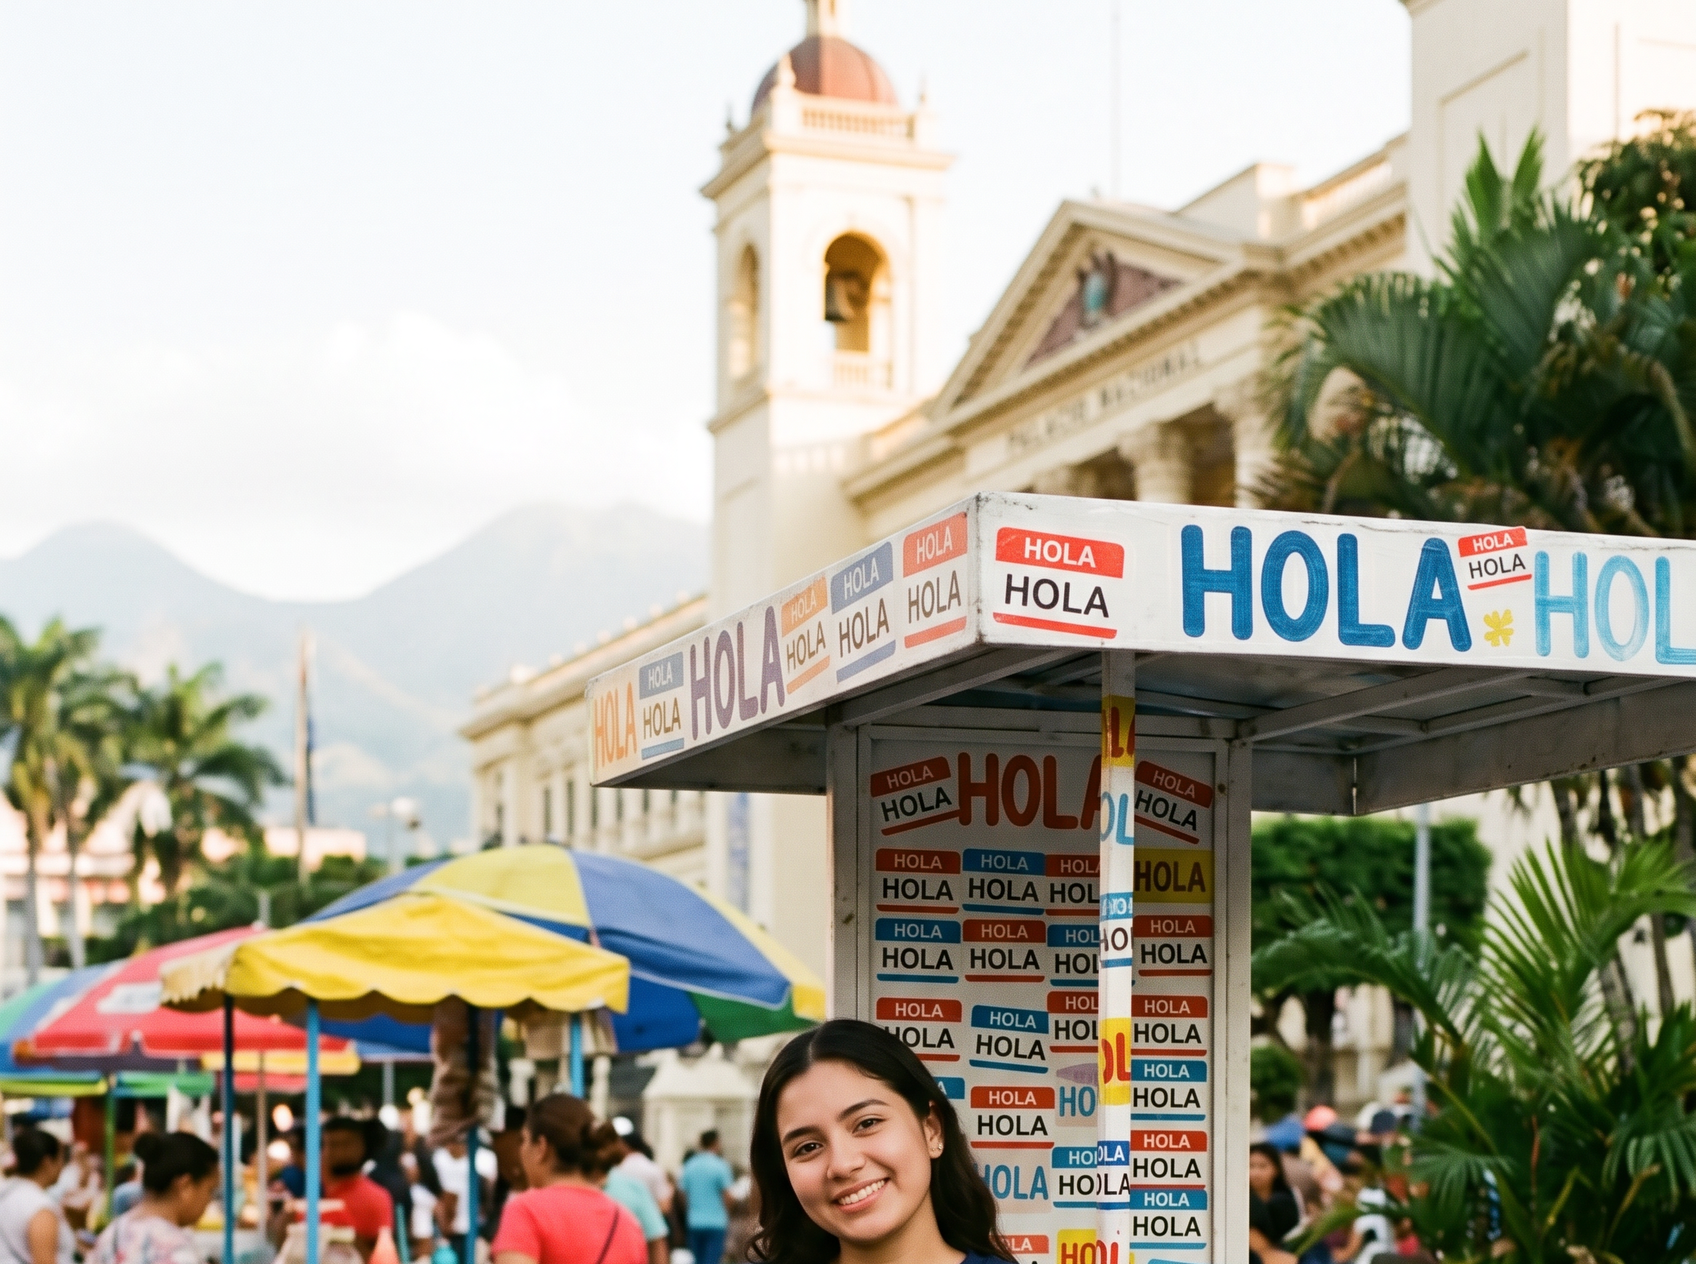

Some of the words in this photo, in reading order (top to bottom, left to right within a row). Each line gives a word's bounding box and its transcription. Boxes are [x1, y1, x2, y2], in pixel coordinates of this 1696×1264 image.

[917, 526, 952, 564] HOLA
[1024, 537, 1096, 568] HOLA
[1473, 533, 1514, 552] HOLA
[1469, 554, 1526, 579] HOLA
[843, 558, 879, 600] HOLA
[1181, 524, 1472, 652] HOLA
[908, 570, 962, 624] HOLA
[1004, 574, 1109, 618] HOLA
[790, 597, 817, 622] HOLA
[1534, 550, 1696, 665] HOL
[838, 598, 890, 658] HOLA
[786, 621, 826, 674] HOLA
[648, 660, 673, 690] HOLA
[689, 606, 785, 741] HOLA
[594, 681, 637, 769] HOLA
[643, 697, 681, 739] HOLA
[887, 766, 934, 789] HOLA
[1152, 770, 1196, 799] HOLA
[881, 787, 952, 822] HOLA
[1134, 789, 1198, 831] HOLA
[894, 854, 942, 869] HOLA
[981, 855, 1028, 871] HOLA
[1134, 861, 1206, 893] HOLA
[883, 878, 954, 901] HOLA
[968, 878, 1039, 902] HOLA
[1050, 883, 1101, 903] HOL
[894, 923, 942, 939] HOLA
[981, 924, 1028, 939] HOLA
[1065, 929, 1100, 943] HOL
[1150, 919, 1196, 934] HOLA
[883, 947, 954, 970] HOLA
[970, 949, 1040, 969] HOLA
[1141, 944, 1207, 964] HOLA
[895, 1003, 943, 1017] HOLA
[1065, 996, 1098, 1010] HOL
[1144, 1000, 1191, 1015] HOLA
[990, 1011, 1037, 1029] HOLA
[1134, 1023, 1201, 1043] HOLA
[976, 1034, 1046, 1060] HOLA
[1144, 1064, 1190, 1078] HOLA
[989, 1090, 1037, 1104] HOLA
[1059, 1085, 1097, 1118] HO
[1133, 1088, 1200, 1107] HOLA
[978, 1115, 1048, 1136] HOLA
[1144, 1133, 1191, 1148] HOLA
[1133, 1158, 1201, 1178] HOLA
[1059, 1175, 1094, 1195] HO
[1144, 1192, 1190, 1207] HOLA
[1144, 1193, 1190, 1206] HOLA
[1133, 1216, 1201, 1236] HOLA
